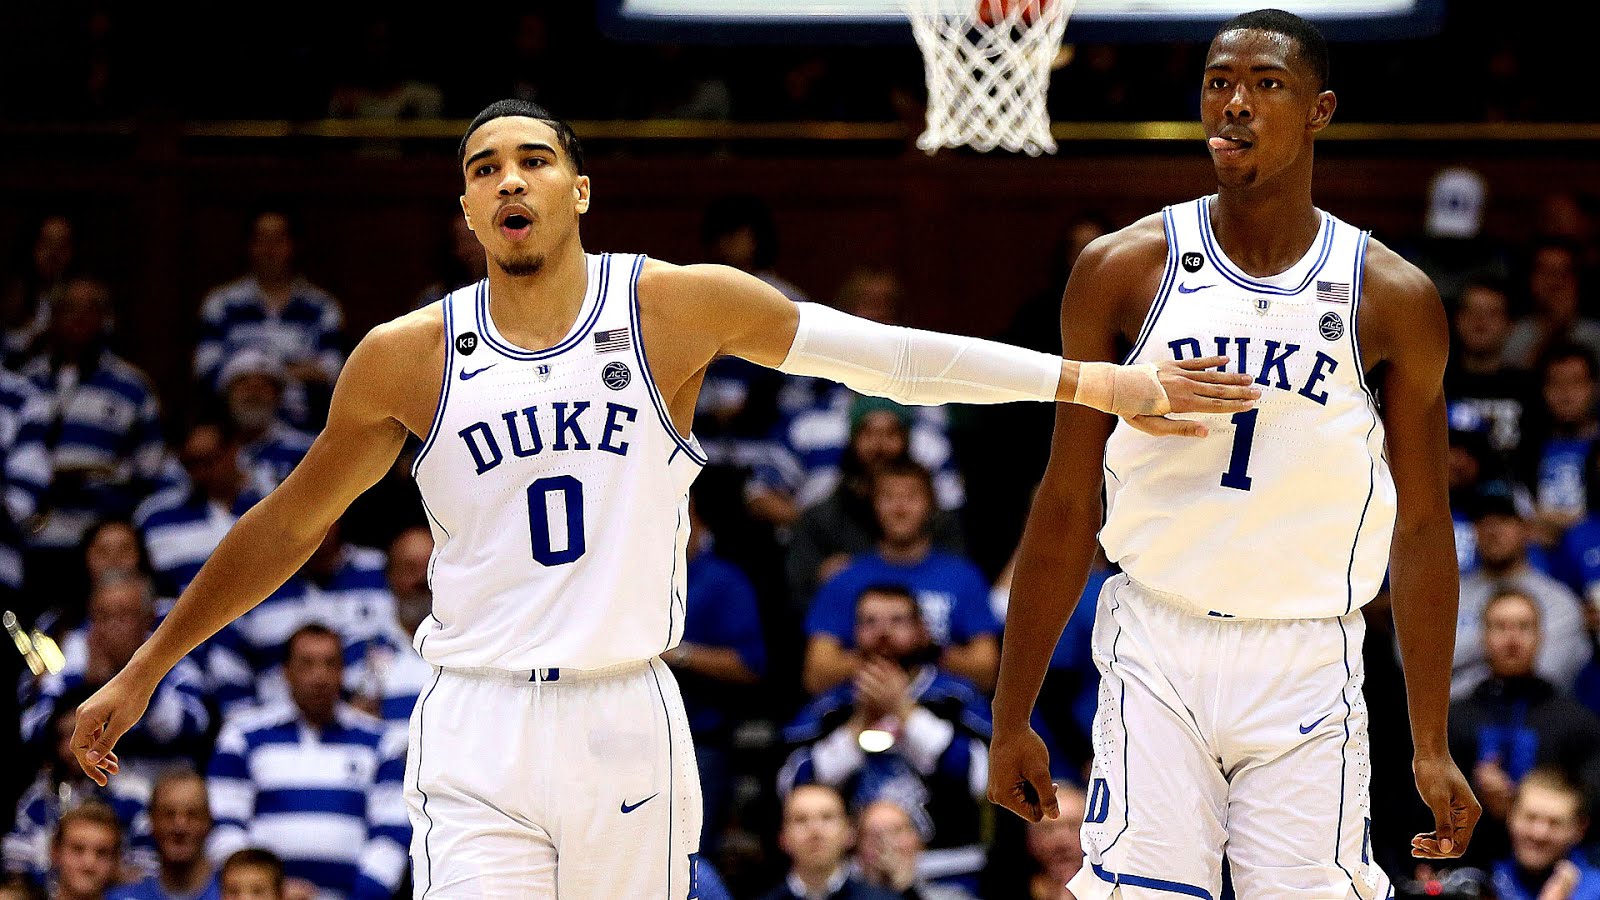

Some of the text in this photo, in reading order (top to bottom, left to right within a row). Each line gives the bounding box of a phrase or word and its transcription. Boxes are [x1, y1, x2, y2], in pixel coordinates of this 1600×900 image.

[1184, 255, 1201, 267] KB
[459, 337, 475, 348] KB
[1322, 321, 1342, 332] ACC
[608, 371, 629, 379] ACC
[1168, 337, 1339, 406] DUKE
[458, 401, 638, 476] DUKE
[1220, 408, 1259, 491] 1
[527, 474, 586, 567] 0
[1084, 778, 1110, 823] D
